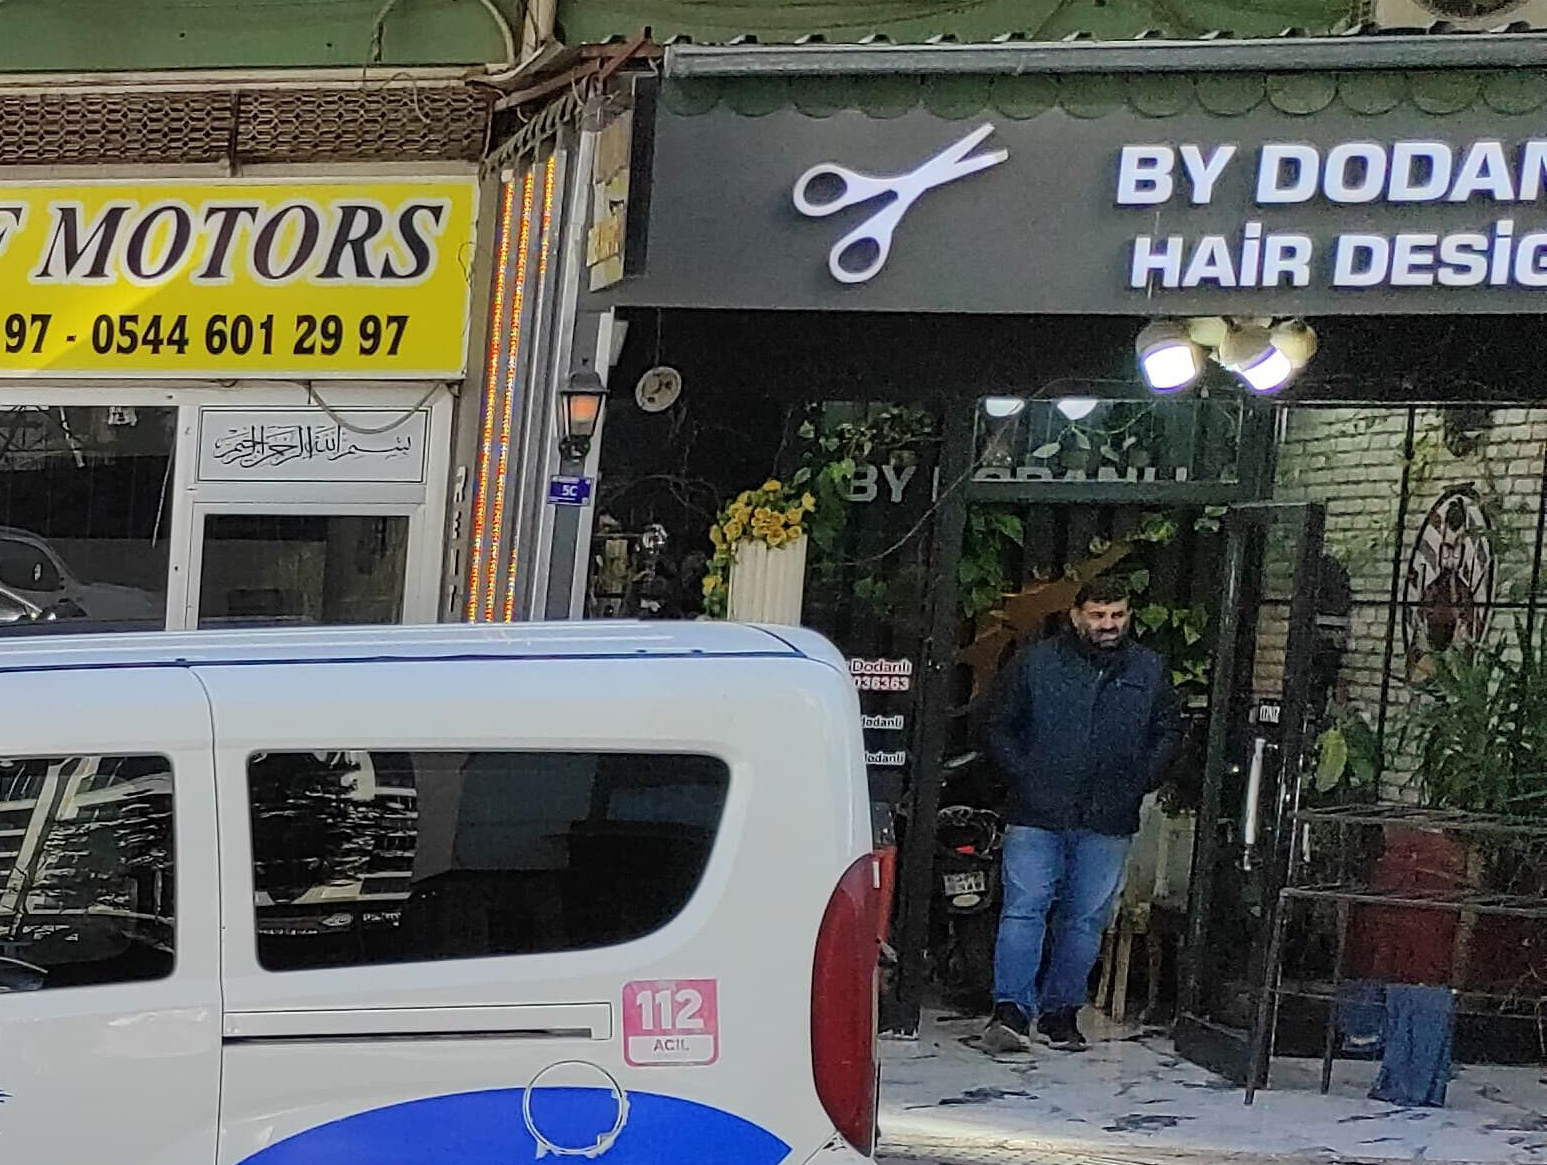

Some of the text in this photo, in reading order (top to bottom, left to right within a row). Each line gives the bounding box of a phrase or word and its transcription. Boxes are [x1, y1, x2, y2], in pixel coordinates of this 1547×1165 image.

[1116, 145, 1237, 205] BY
[36, 205, 442, 280] MOTORS
[4, 313, 52, 353] 97
[91, 314, 190, 355] 0544
[206, 315, 275, 355] 601
[293, 315, 342, 355] 29
[358, 316, 409, 355] 97
[561, 484, 579, 497] 5C
[845, 464, 917, 502] BY
[636, 988, 704, 1031] 112
